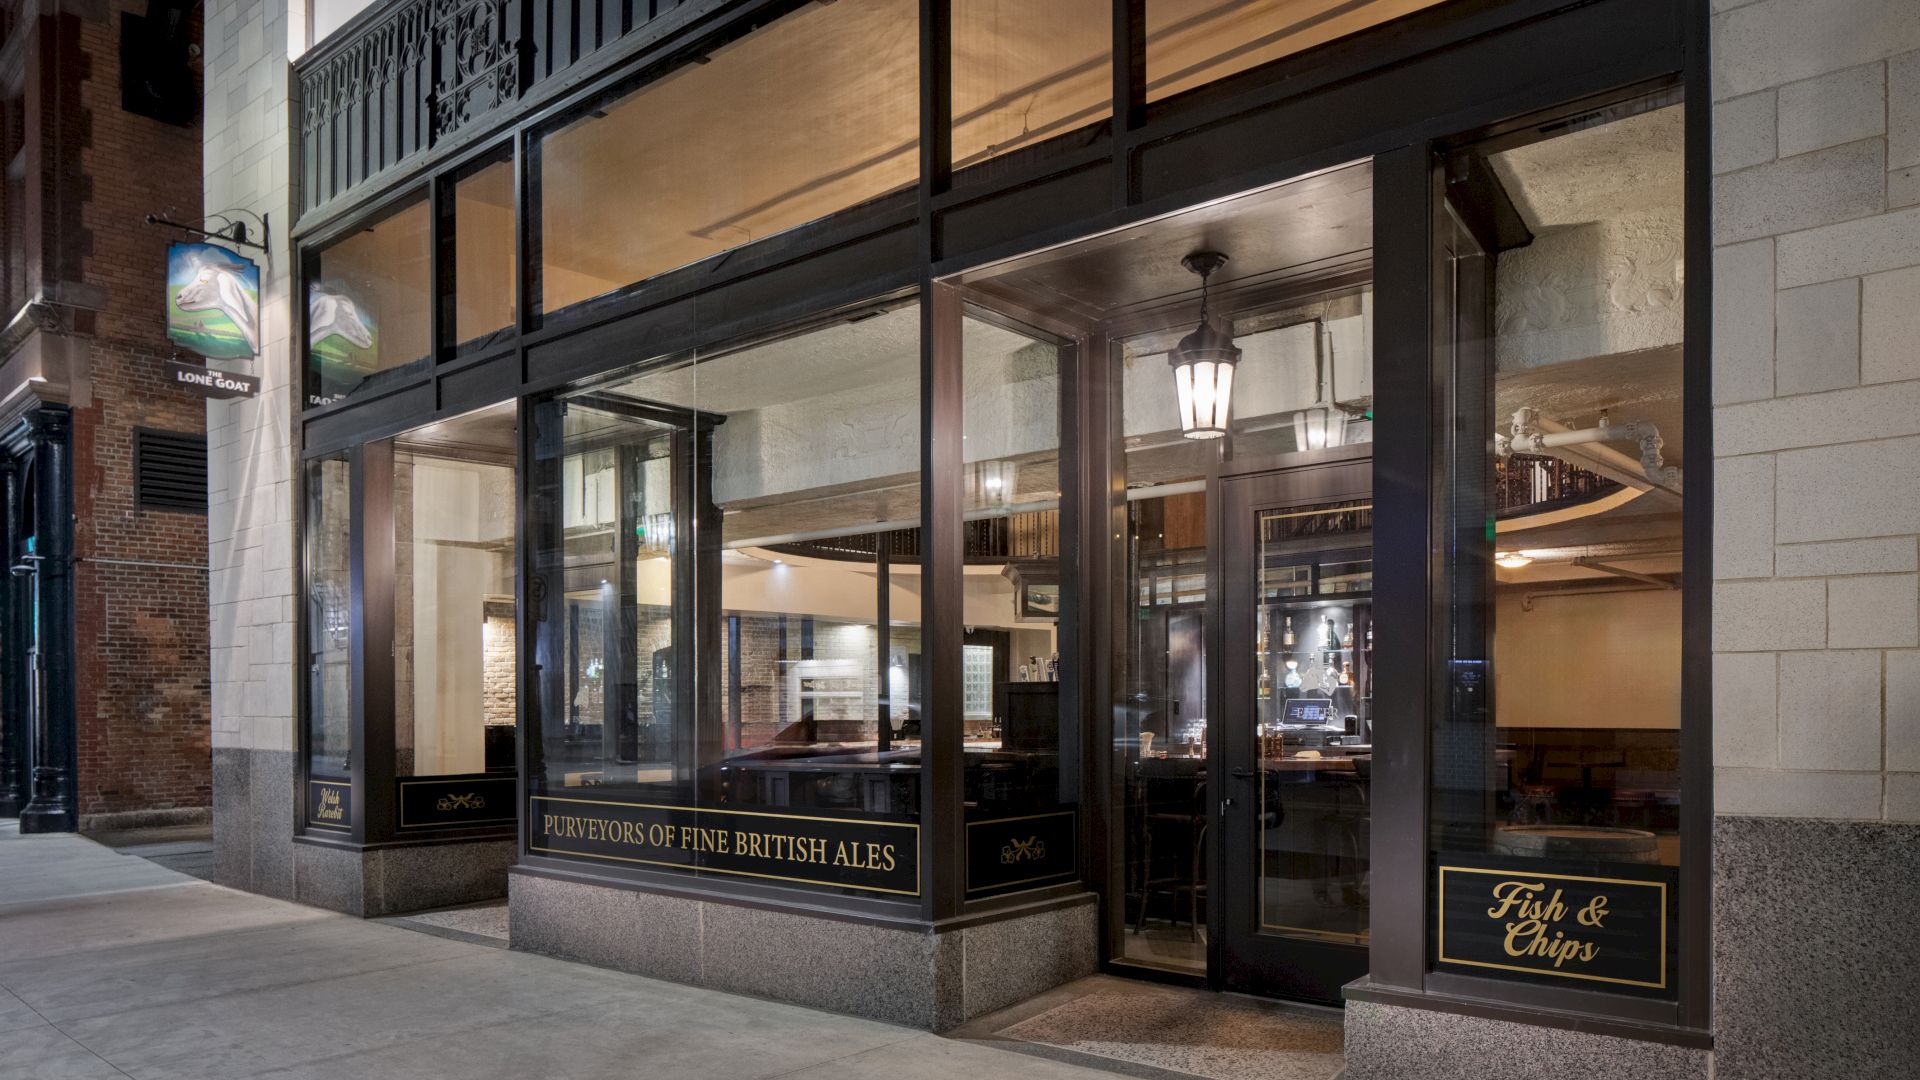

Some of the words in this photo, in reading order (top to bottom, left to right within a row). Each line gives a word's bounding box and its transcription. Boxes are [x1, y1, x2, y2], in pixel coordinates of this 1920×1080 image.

[177, 371, 213, 386] LONE
[215, 378, 250, 392] GOAT
[1297, 707, 1338, 719] ENTER
[321, 788, 340, 805] Welsh
[317, 803, 343, 820] Rarebit
[544, 814, 645, 845] PURVEYORS
[649, 824, 675, 848] OF
[681, 828, 728, 854] FINE
[735, 833, 827, 864] BRITISH
[833, 841, 895, 872] ALES
[1487, 881, 1568, 922] Fish
[1577, 895, 1610, 928] &
[1503, 919, 1600, 968] Chips
